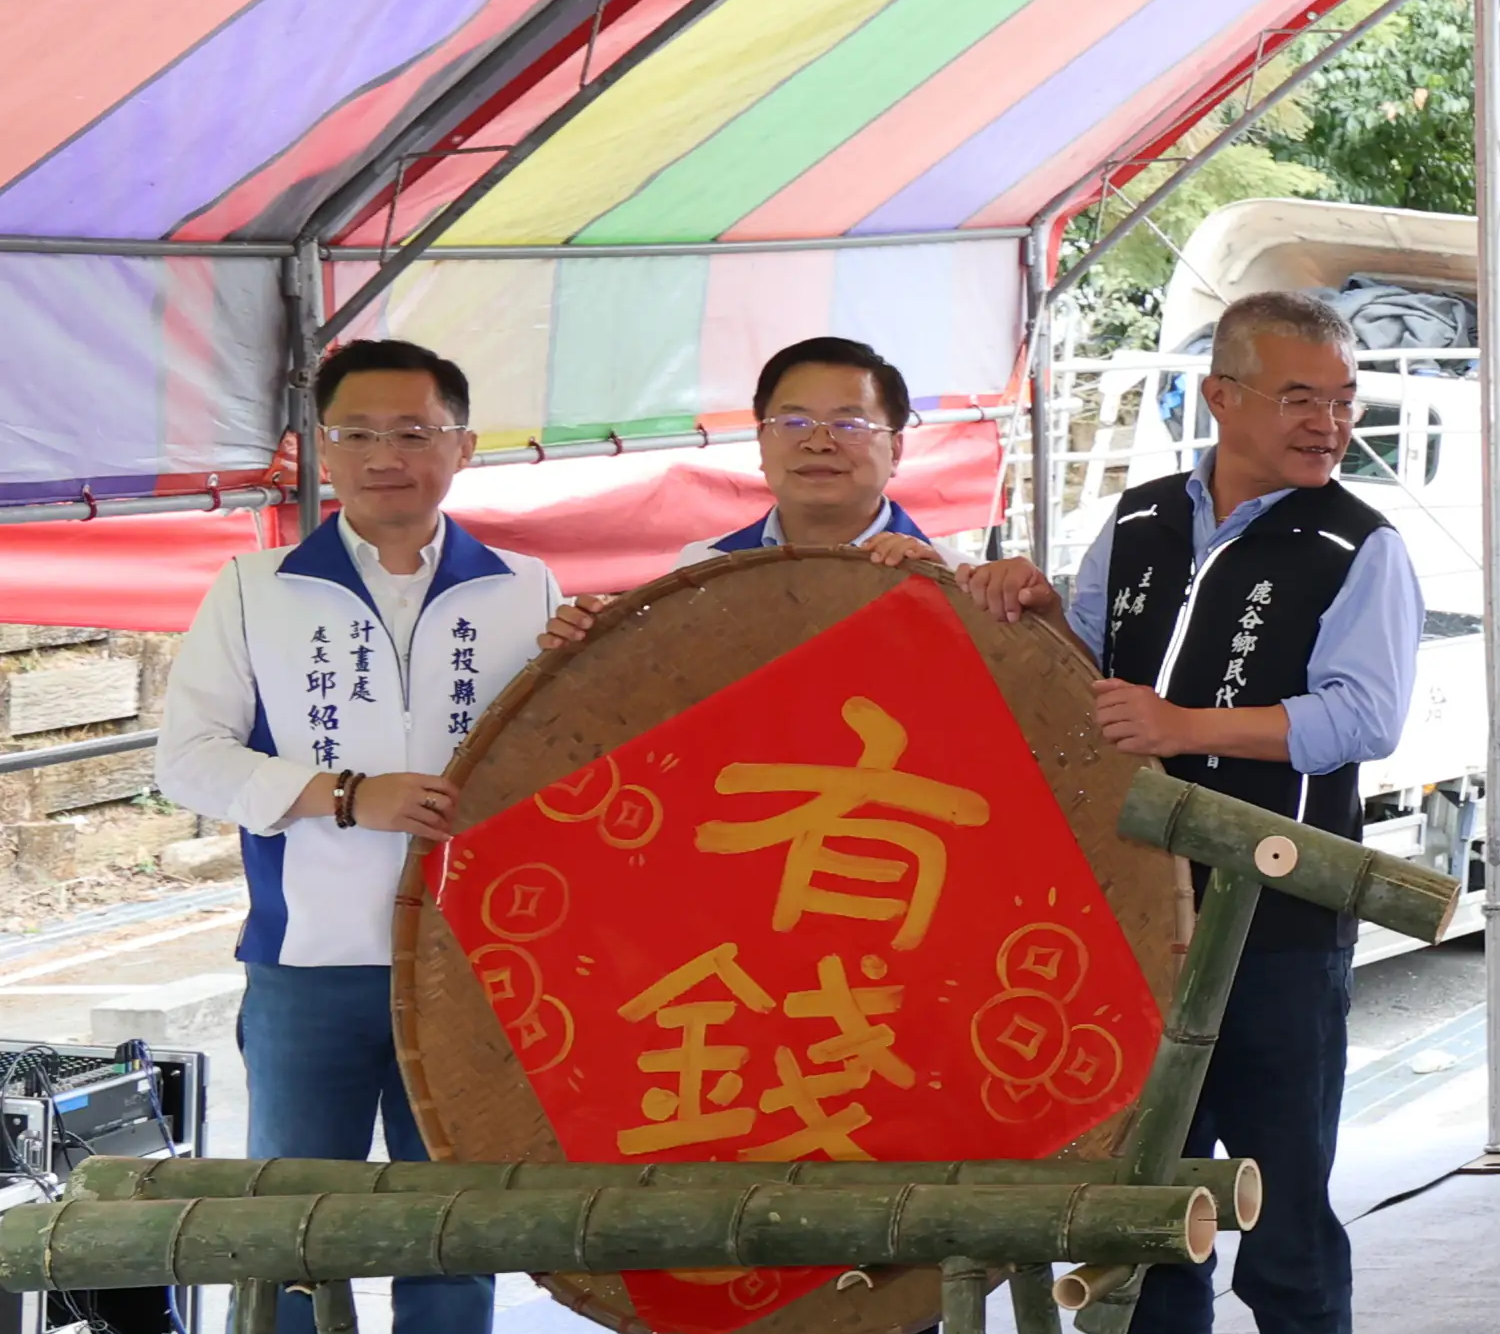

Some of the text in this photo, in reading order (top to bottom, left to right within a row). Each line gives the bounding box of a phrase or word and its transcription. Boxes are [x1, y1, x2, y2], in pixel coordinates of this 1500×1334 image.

[348, 620, 377, 702] 計畫處
[448, 618, 479, 753] 南投縣政
